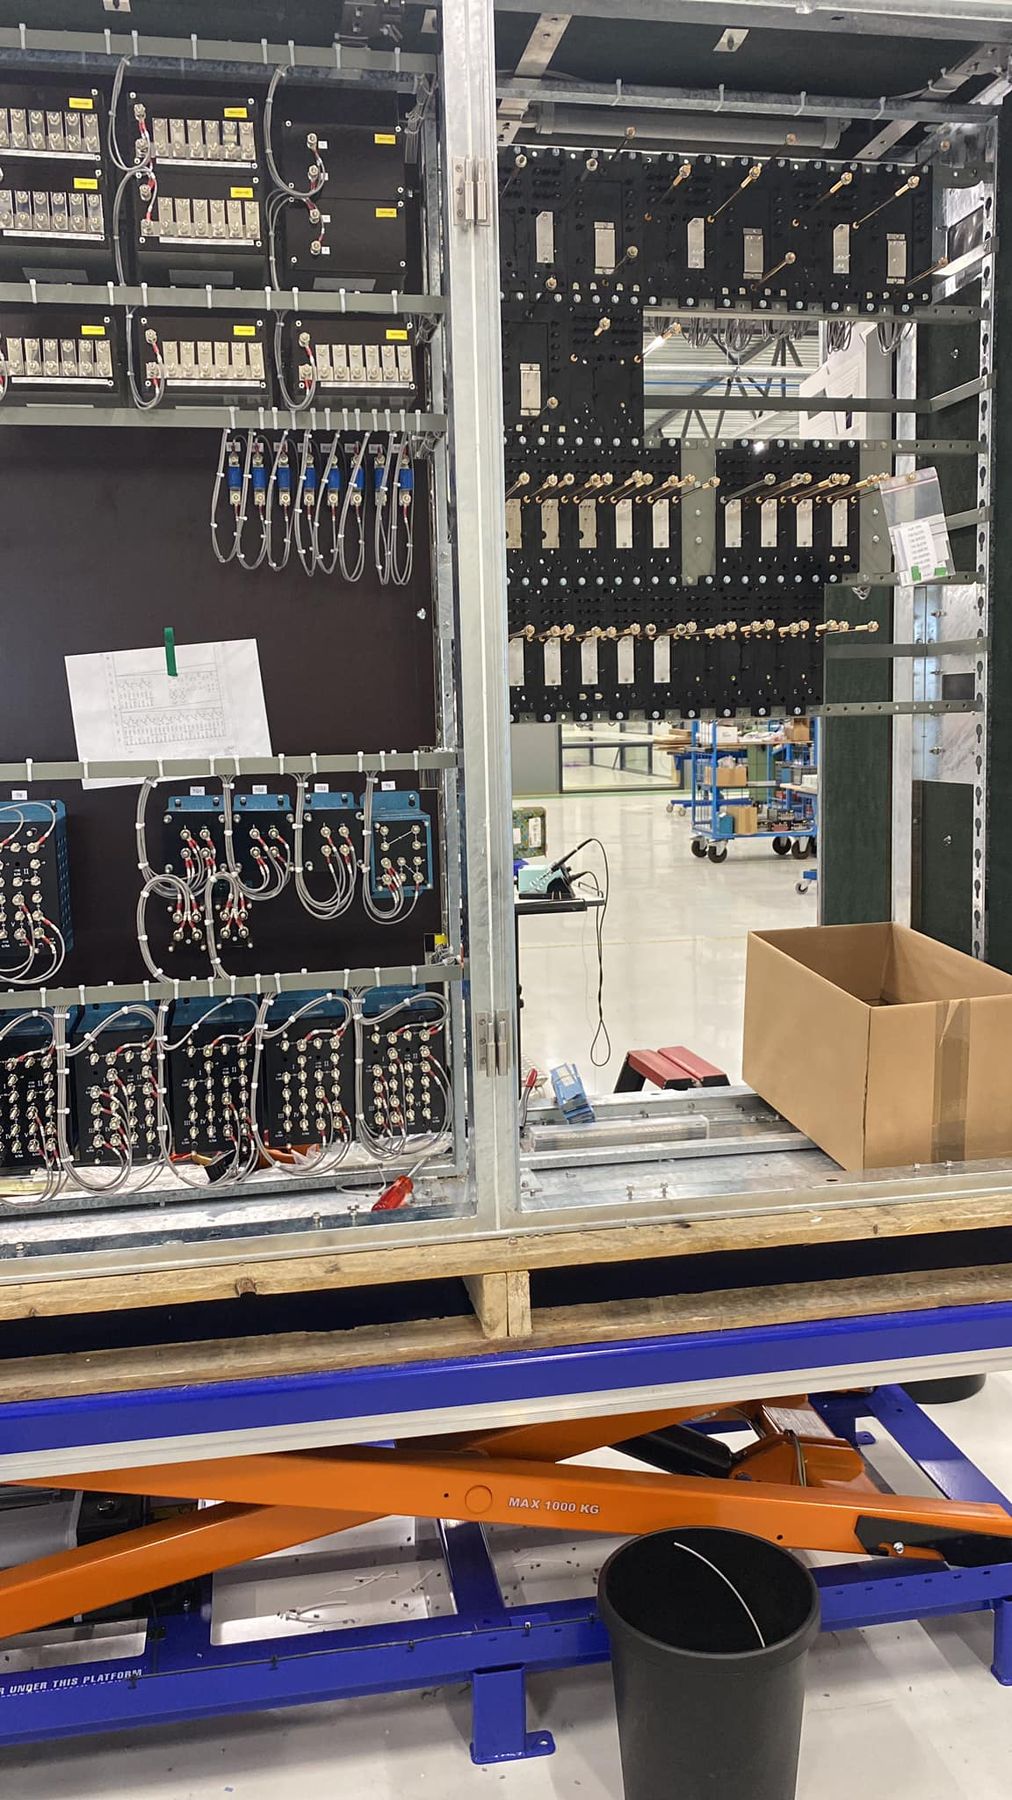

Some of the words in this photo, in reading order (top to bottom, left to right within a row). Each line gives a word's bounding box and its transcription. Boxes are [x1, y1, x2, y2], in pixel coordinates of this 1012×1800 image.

[508, 1497, 540, 1509] MAX
[545, 1500, 576, 1512] 1000
[580, 1504, 599, 1514] KG
[10, 1681, 47, 1694] UNDER
[53, 1676, 78, 1688] THIS
[83, 1669, 142, 1684] PLATFORM
